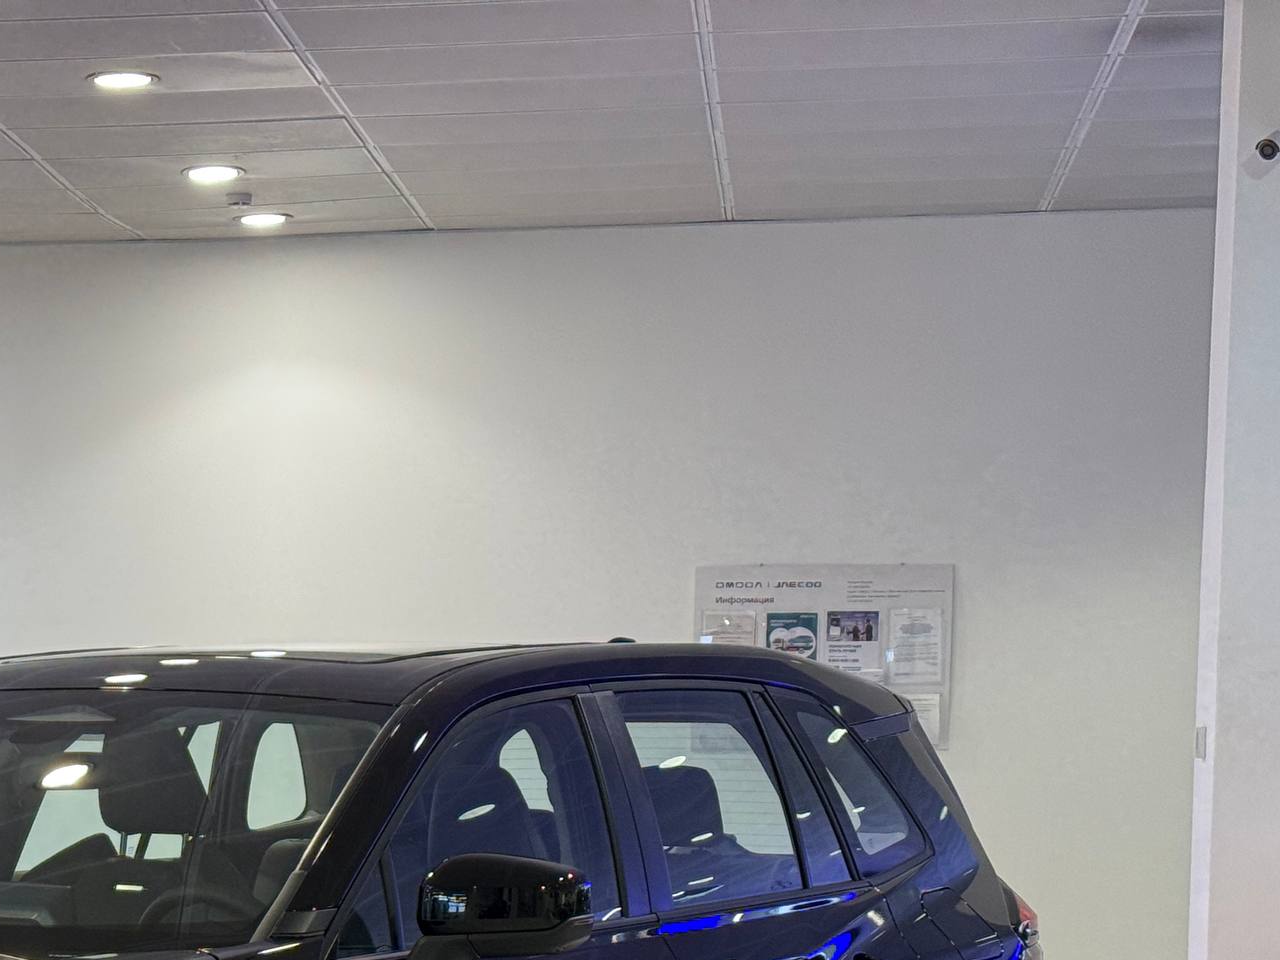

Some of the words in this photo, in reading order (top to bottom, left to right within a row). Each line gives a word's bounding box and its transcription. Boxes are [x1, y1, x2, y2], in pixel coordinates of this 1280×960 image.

[715, 581, 762, 589] OMODA
[774, 581, 822, 589] JAECOO
[715, 597, 775, 605] Информация
